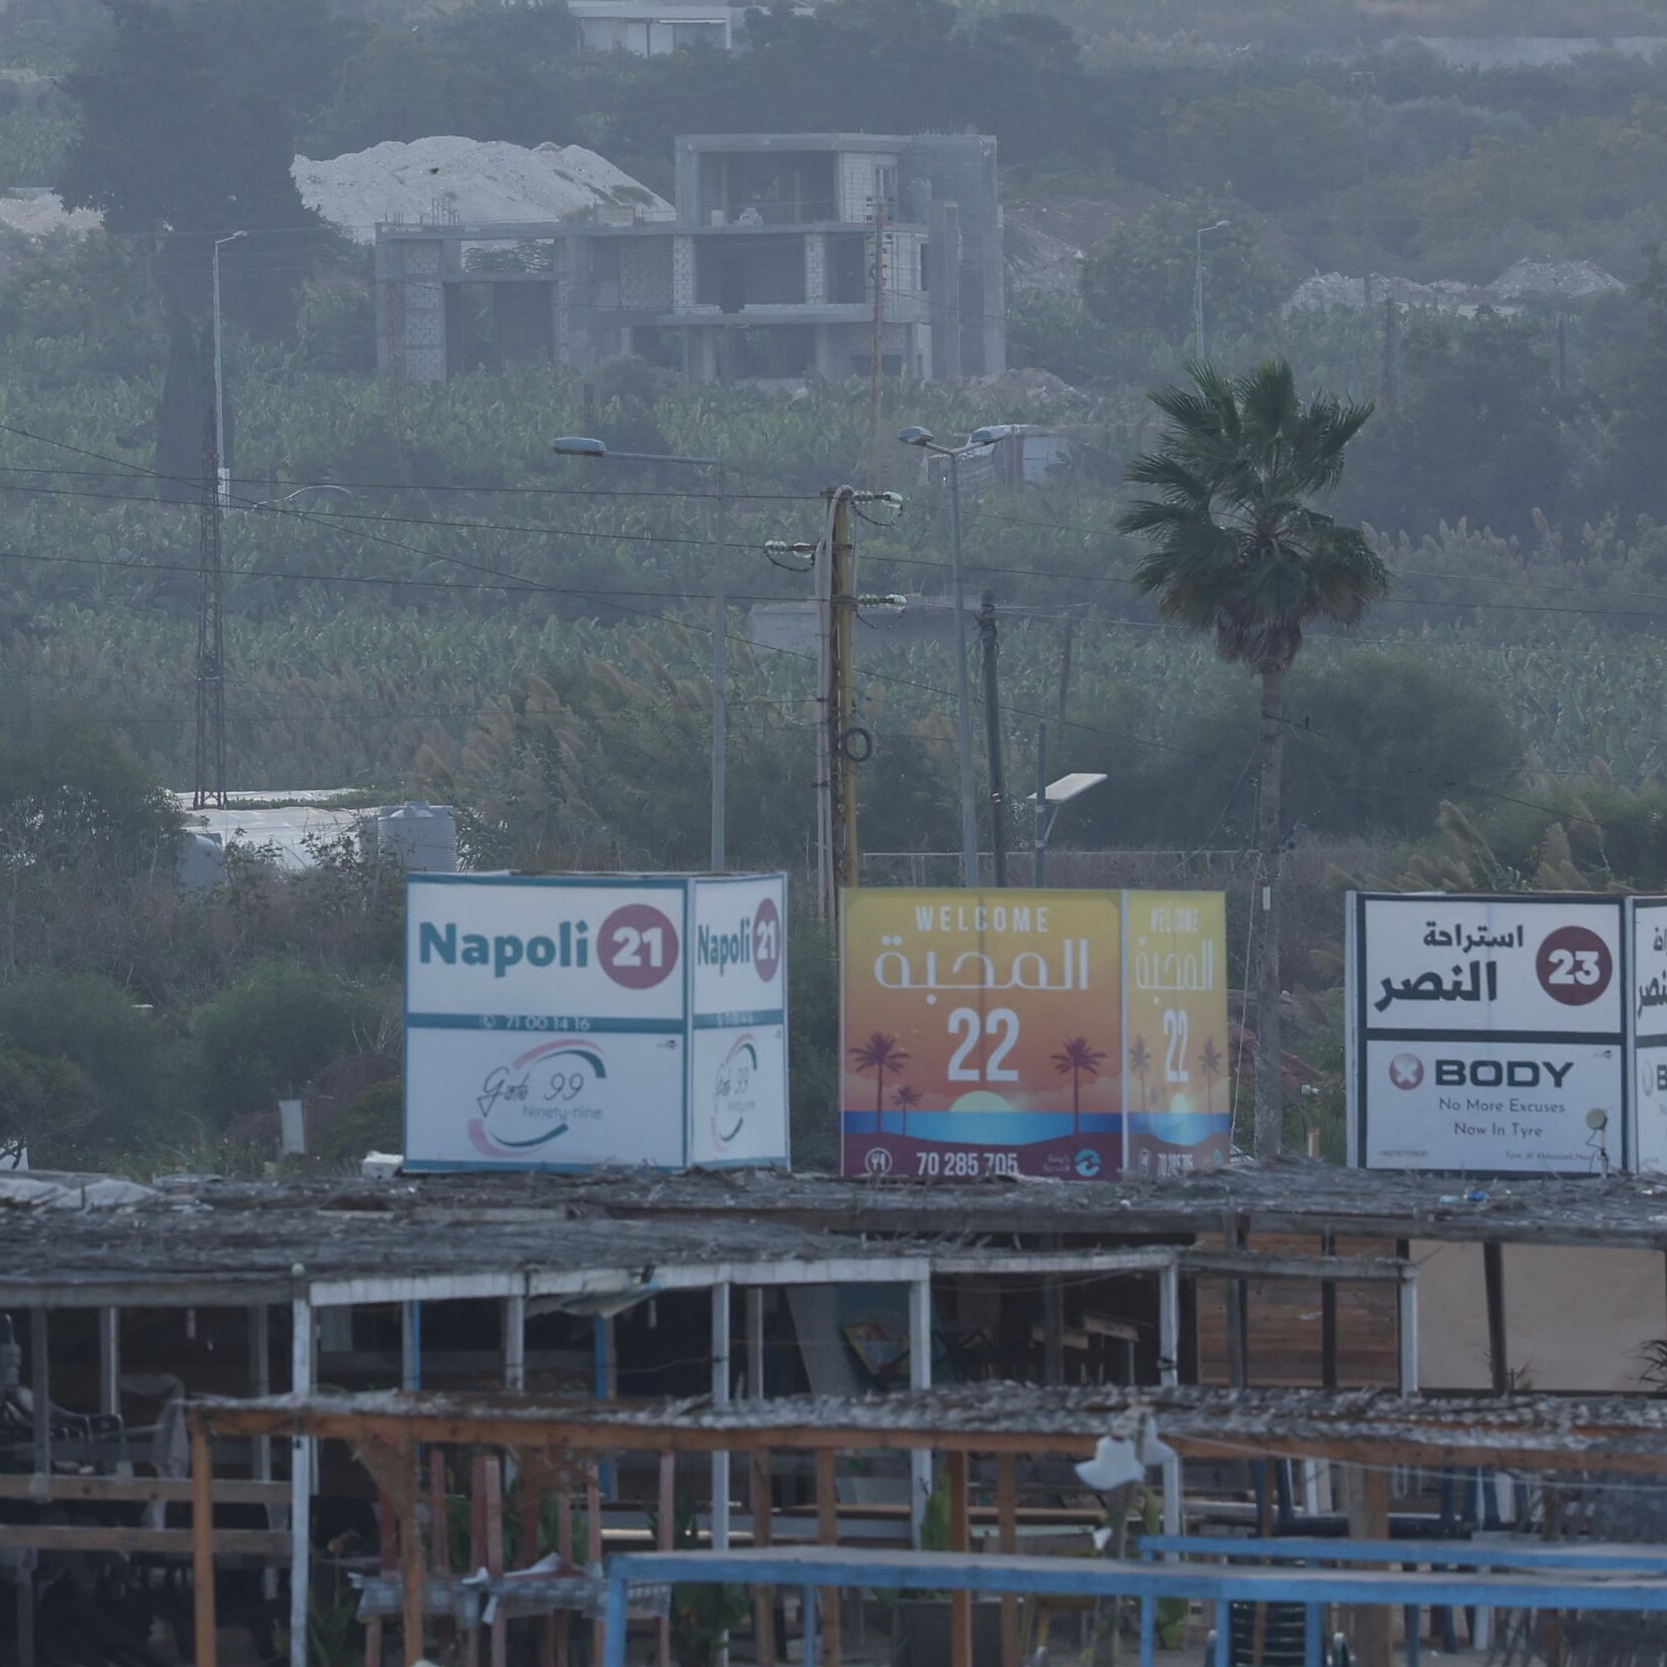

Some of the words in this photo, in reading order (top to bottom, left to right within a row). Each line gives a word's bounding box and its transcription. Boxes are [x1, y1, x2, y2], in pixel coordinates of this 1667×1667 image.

[916, 906, 1048, 932] WELCOME
[419, 920, 589, 978] Napoli
[612, 926, 663, 967] 21
[697, 917, 750, 977] Napoli
[757, 920, 776, 960] 21
[1423, 921, 1523, 953] استراحة
[874, 935, 1089, 1005] المحبة
[1548, 949, 1601, 985] 23
[1374, 960, 1497, 1012] النصر
[507, 1014, 519, 1029] 71
[525, 1015, 548, 1030] 00
[554, 1016, 567, 1031] 14
[575, 1016, 590, 1031] 16
[947, 1007, 1019, 1082] 22
[1163, 1009, 1189, 1082] 22
[543, 1073, 584, 1100] 99
[1435, 1059, 1574, 1088] BODY
[522, 1104, 602, 1120] Ninety-nine
[1439, 1097, 1460, 1111] No
[1467, 1098, 1503, 1112] More
[1510, 1098, 1565, 1113] Excuses
[1454, 1122, 1486, 1135] Now
[1492, 1122, 1505, 1135] In
[1511, 1122, 1544, 1138] Tyre
[917, 1152, 939, 1175] 70
[944, 1153, 978, 1175] 285
[984, 1153, 1018, 1176] 705
